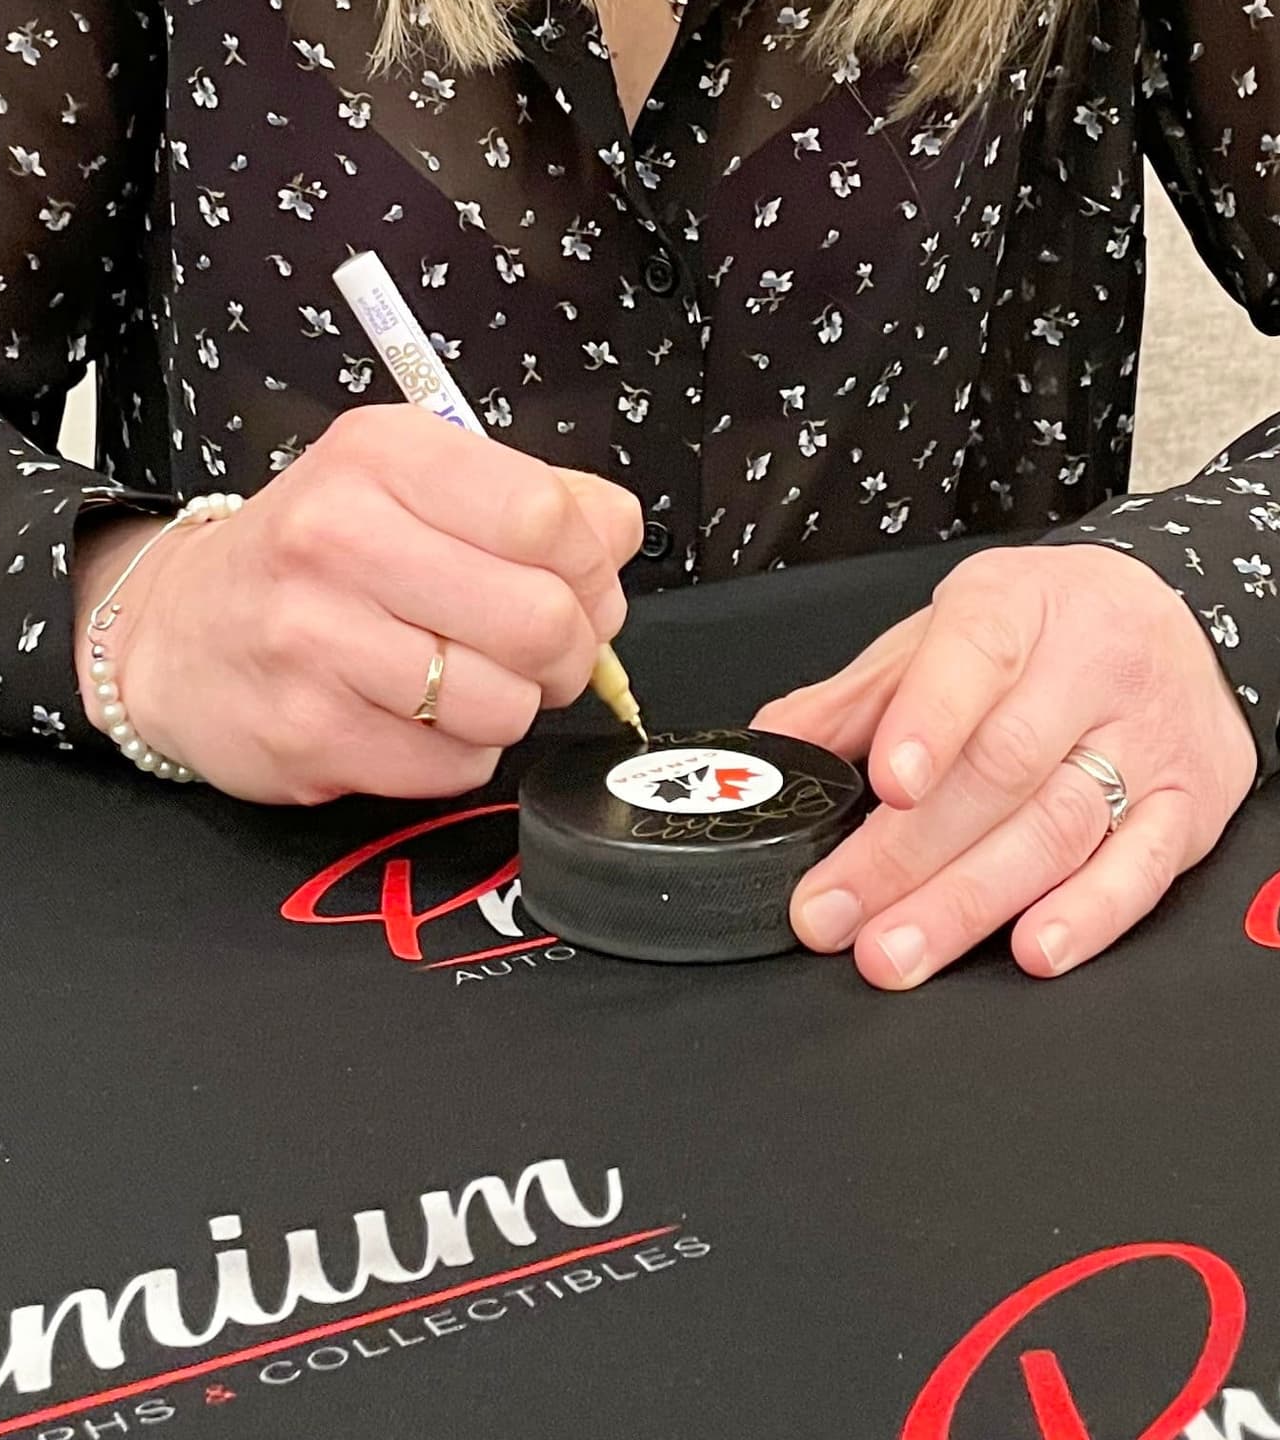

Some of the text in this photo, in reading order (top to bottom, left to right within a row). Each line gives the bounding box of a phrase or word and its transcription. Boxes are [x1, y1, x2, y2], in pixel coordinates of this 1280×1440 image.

[385, 345, 429, 403] LIQUID
[403, 342, 441, 395] GOLD
[258, 1235, 711, 1386] COLLECTIBLES
